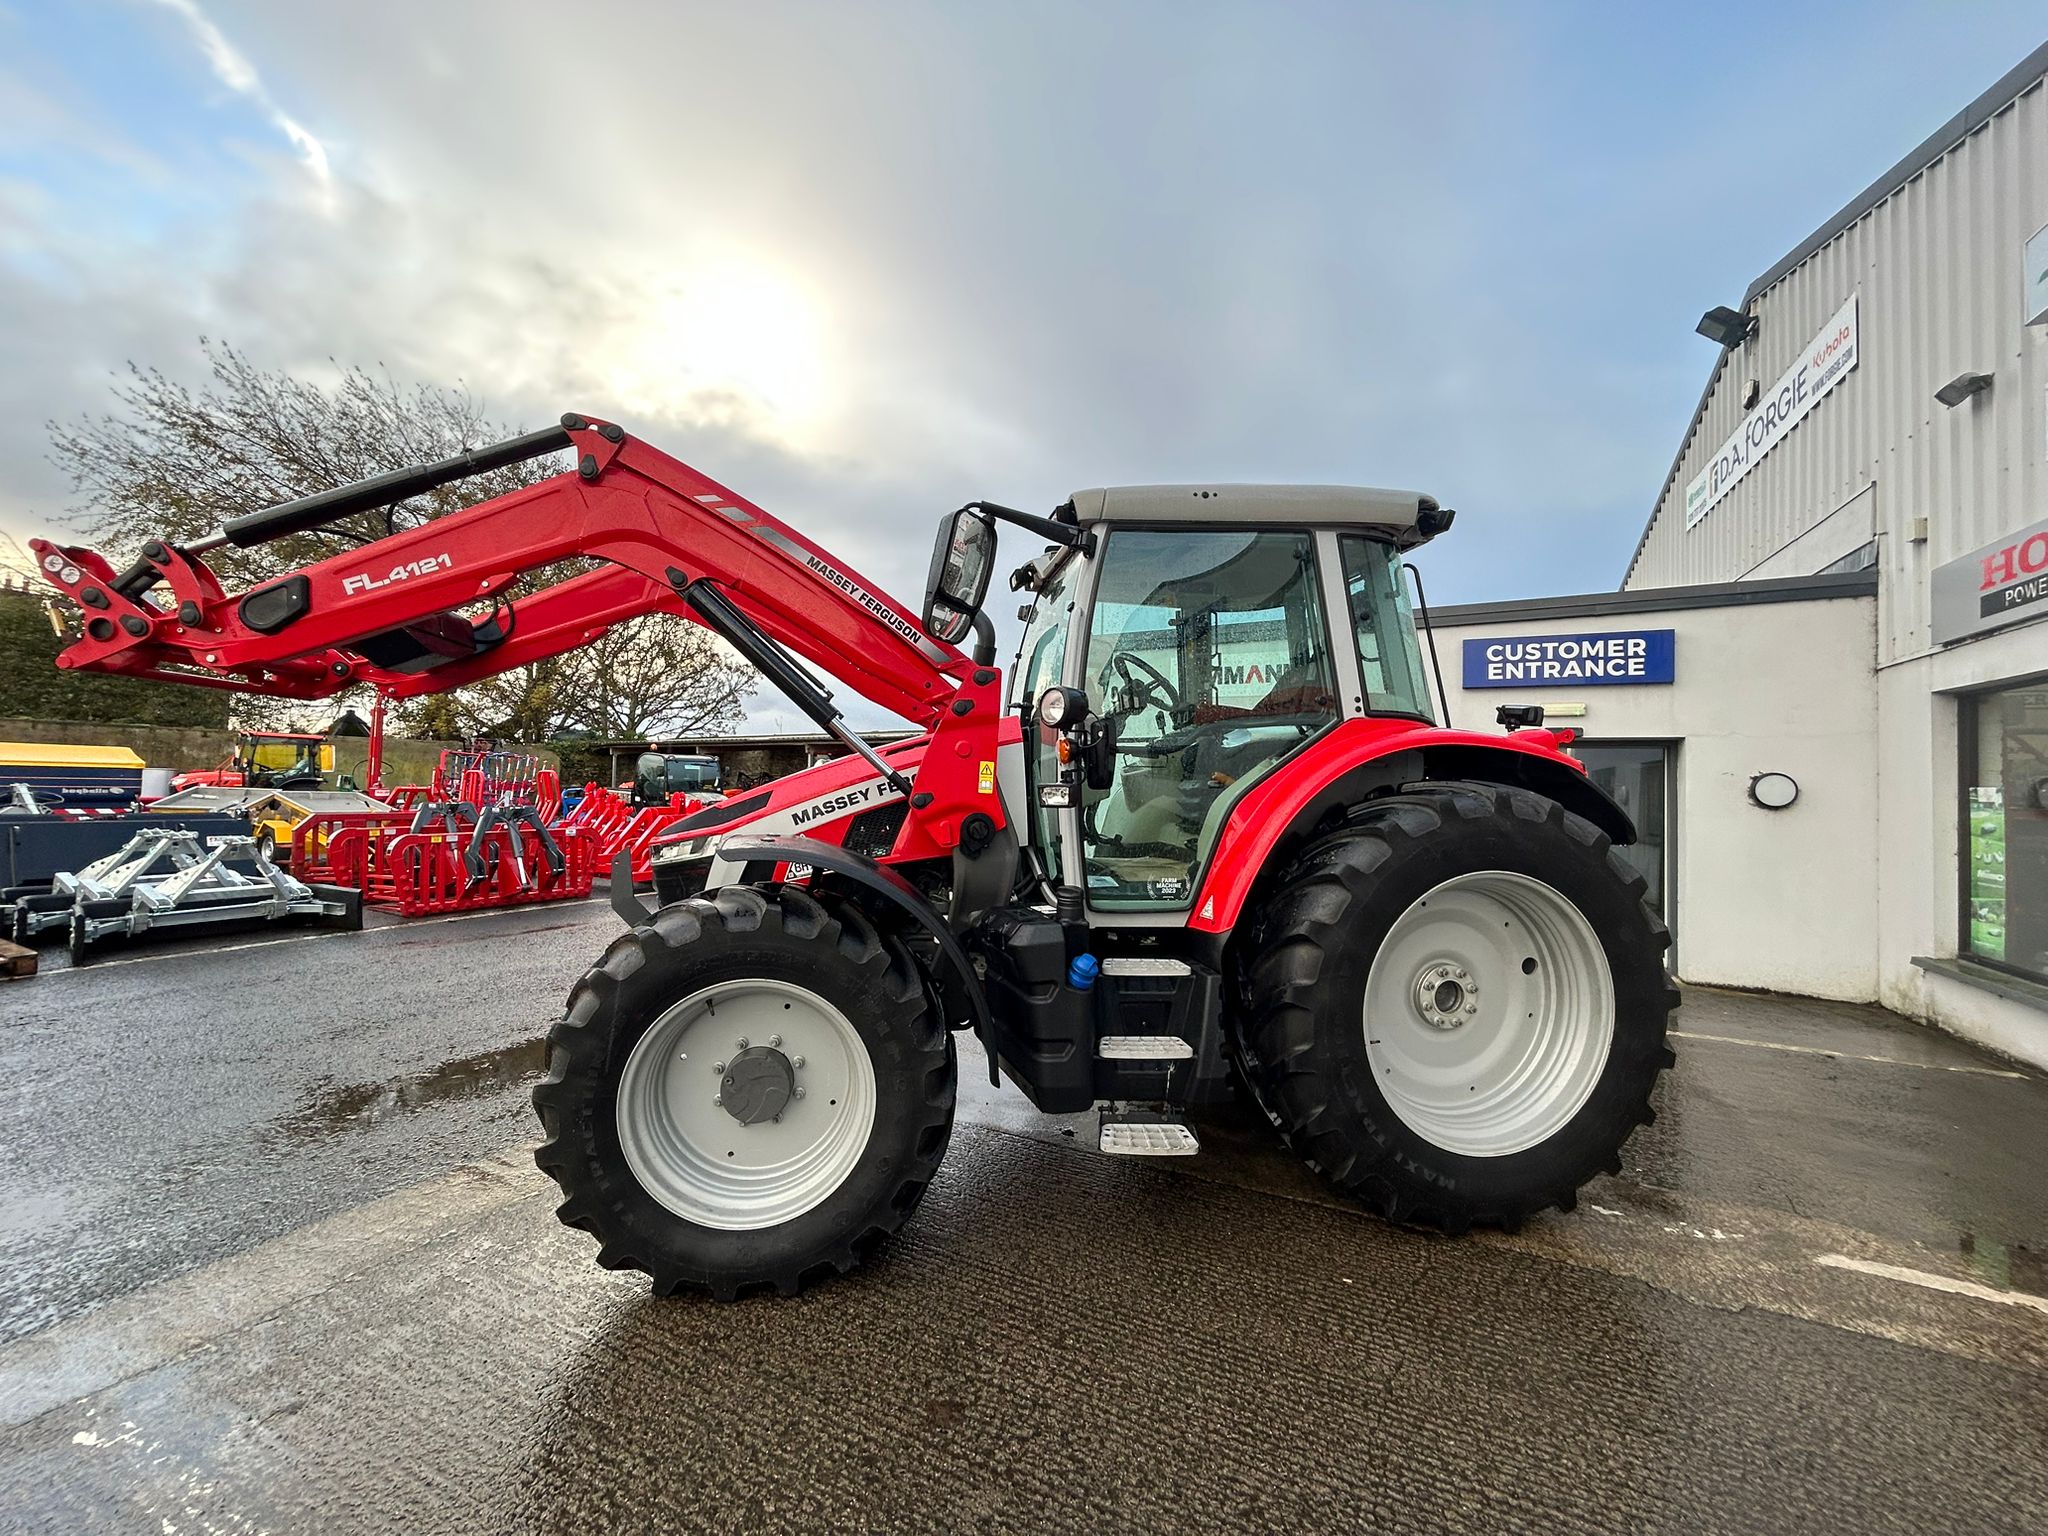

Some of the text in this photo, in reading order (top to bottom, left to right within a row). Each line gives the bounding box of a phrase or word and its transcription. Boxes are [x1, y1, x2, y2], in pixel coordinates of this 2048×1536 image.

[1812, 326, 1850, 369] Kubota
[806, 555, 922, 644] MASSEY FERGUSON
[1486, 638, 1647, 662] CUSTOMER
[1487, 657, 1646, 680] ENTRANCE
[791, 787, 870, 826] MASSEY
